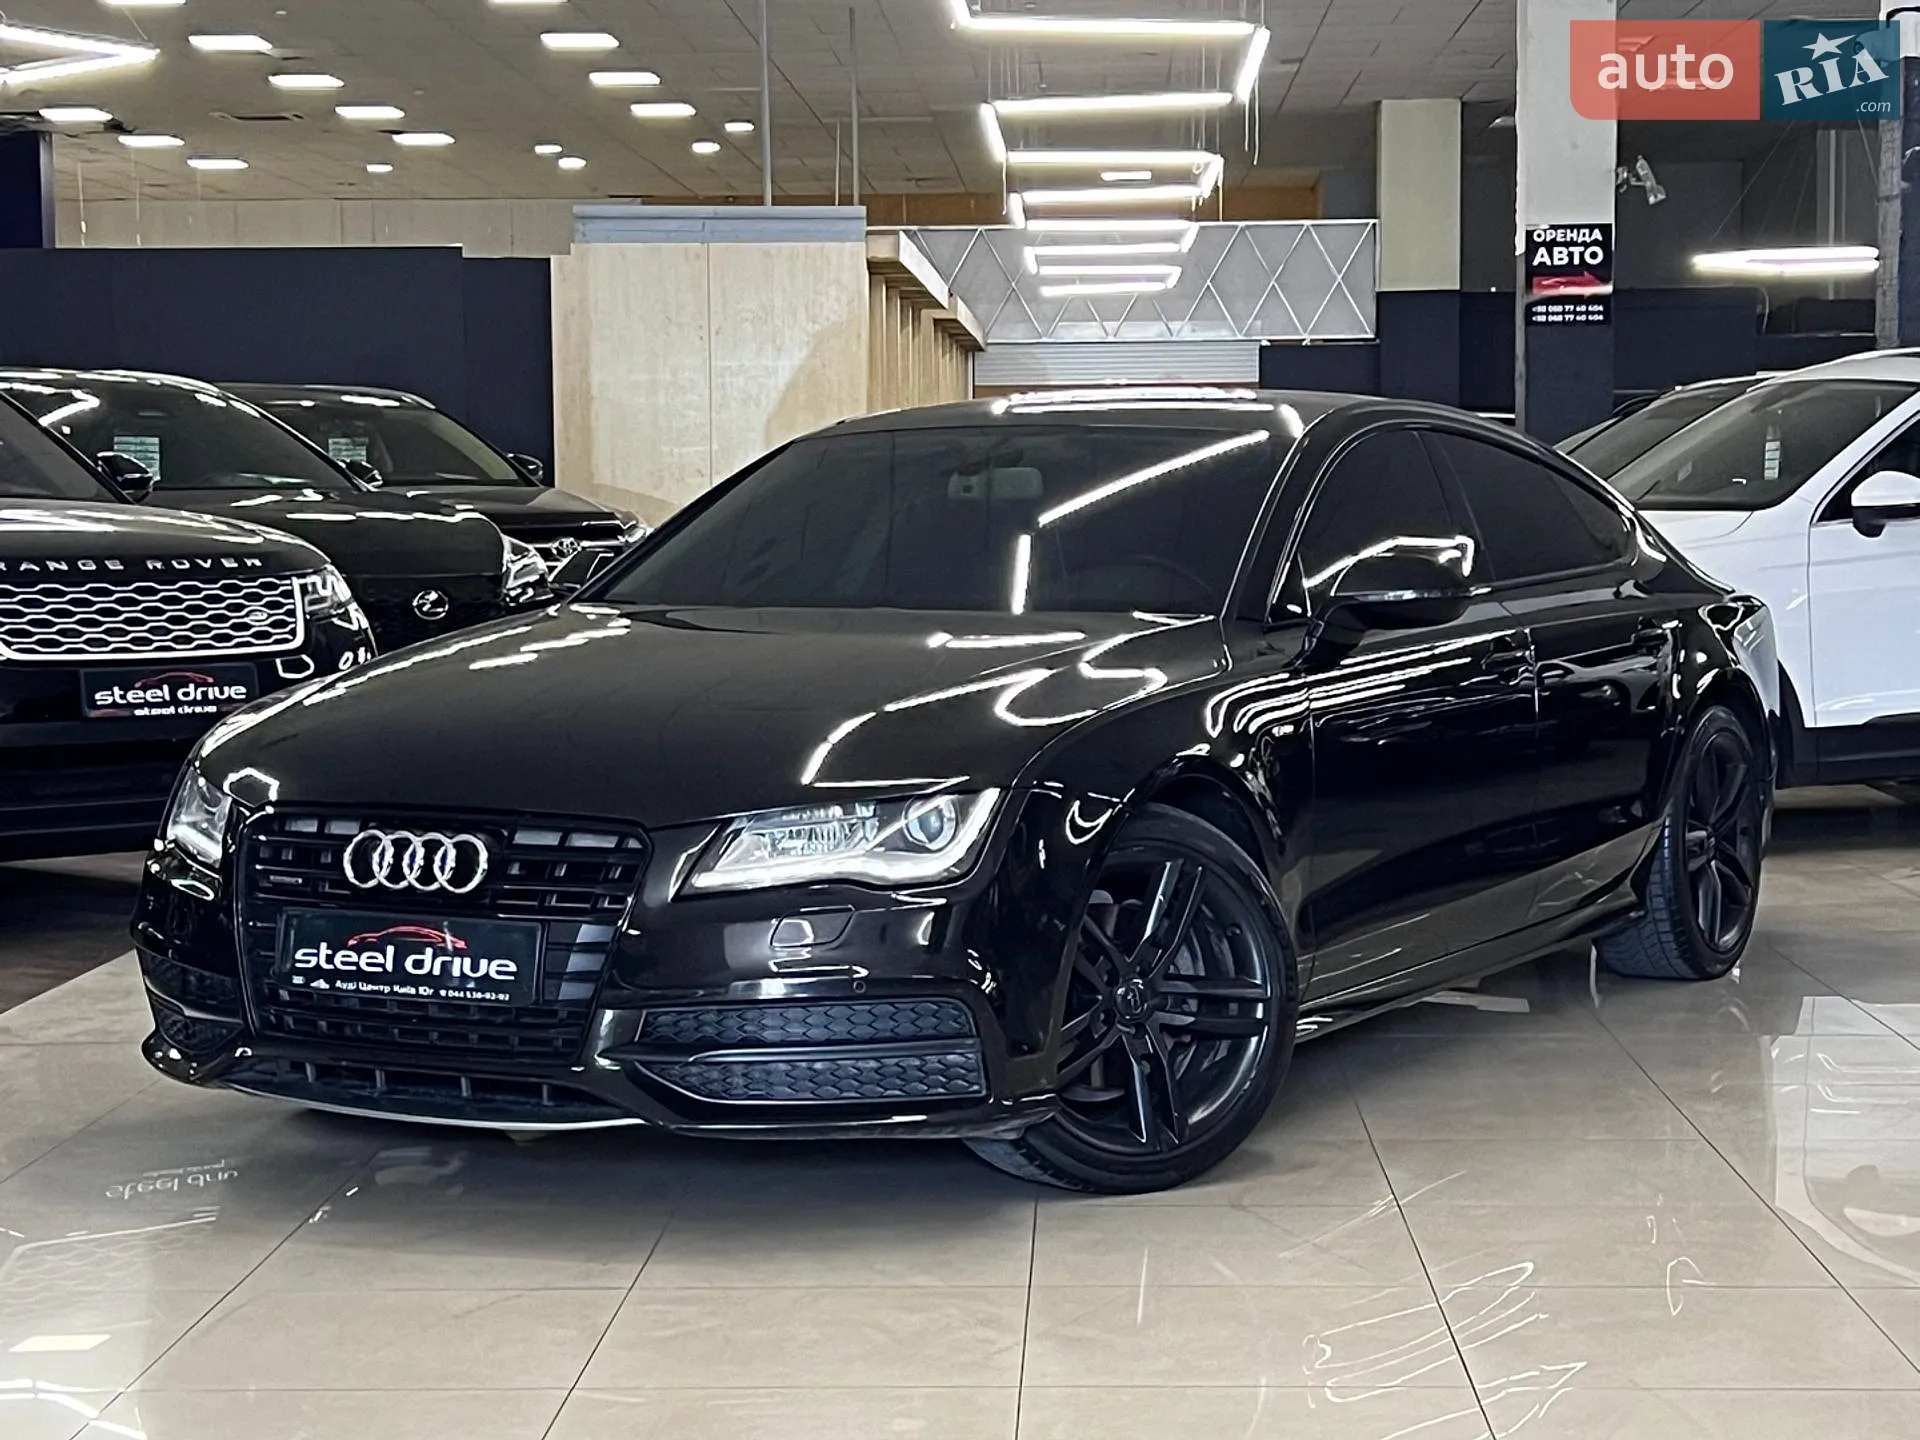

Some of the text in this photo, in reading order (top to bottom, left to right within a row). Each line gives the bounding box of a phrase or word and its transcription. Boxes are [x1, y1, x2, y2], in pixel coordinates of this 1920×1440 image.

[1533, 228, 1603, 243] ОРЕНДА
[1532, 246, 1604, 266] АВТО
[145, 557, 263, 571] ROVER
[94, 683, 247, 706] steel drive
[294, 942, 518, 981] steel drive
[358, 981, 391, 994] Центр
